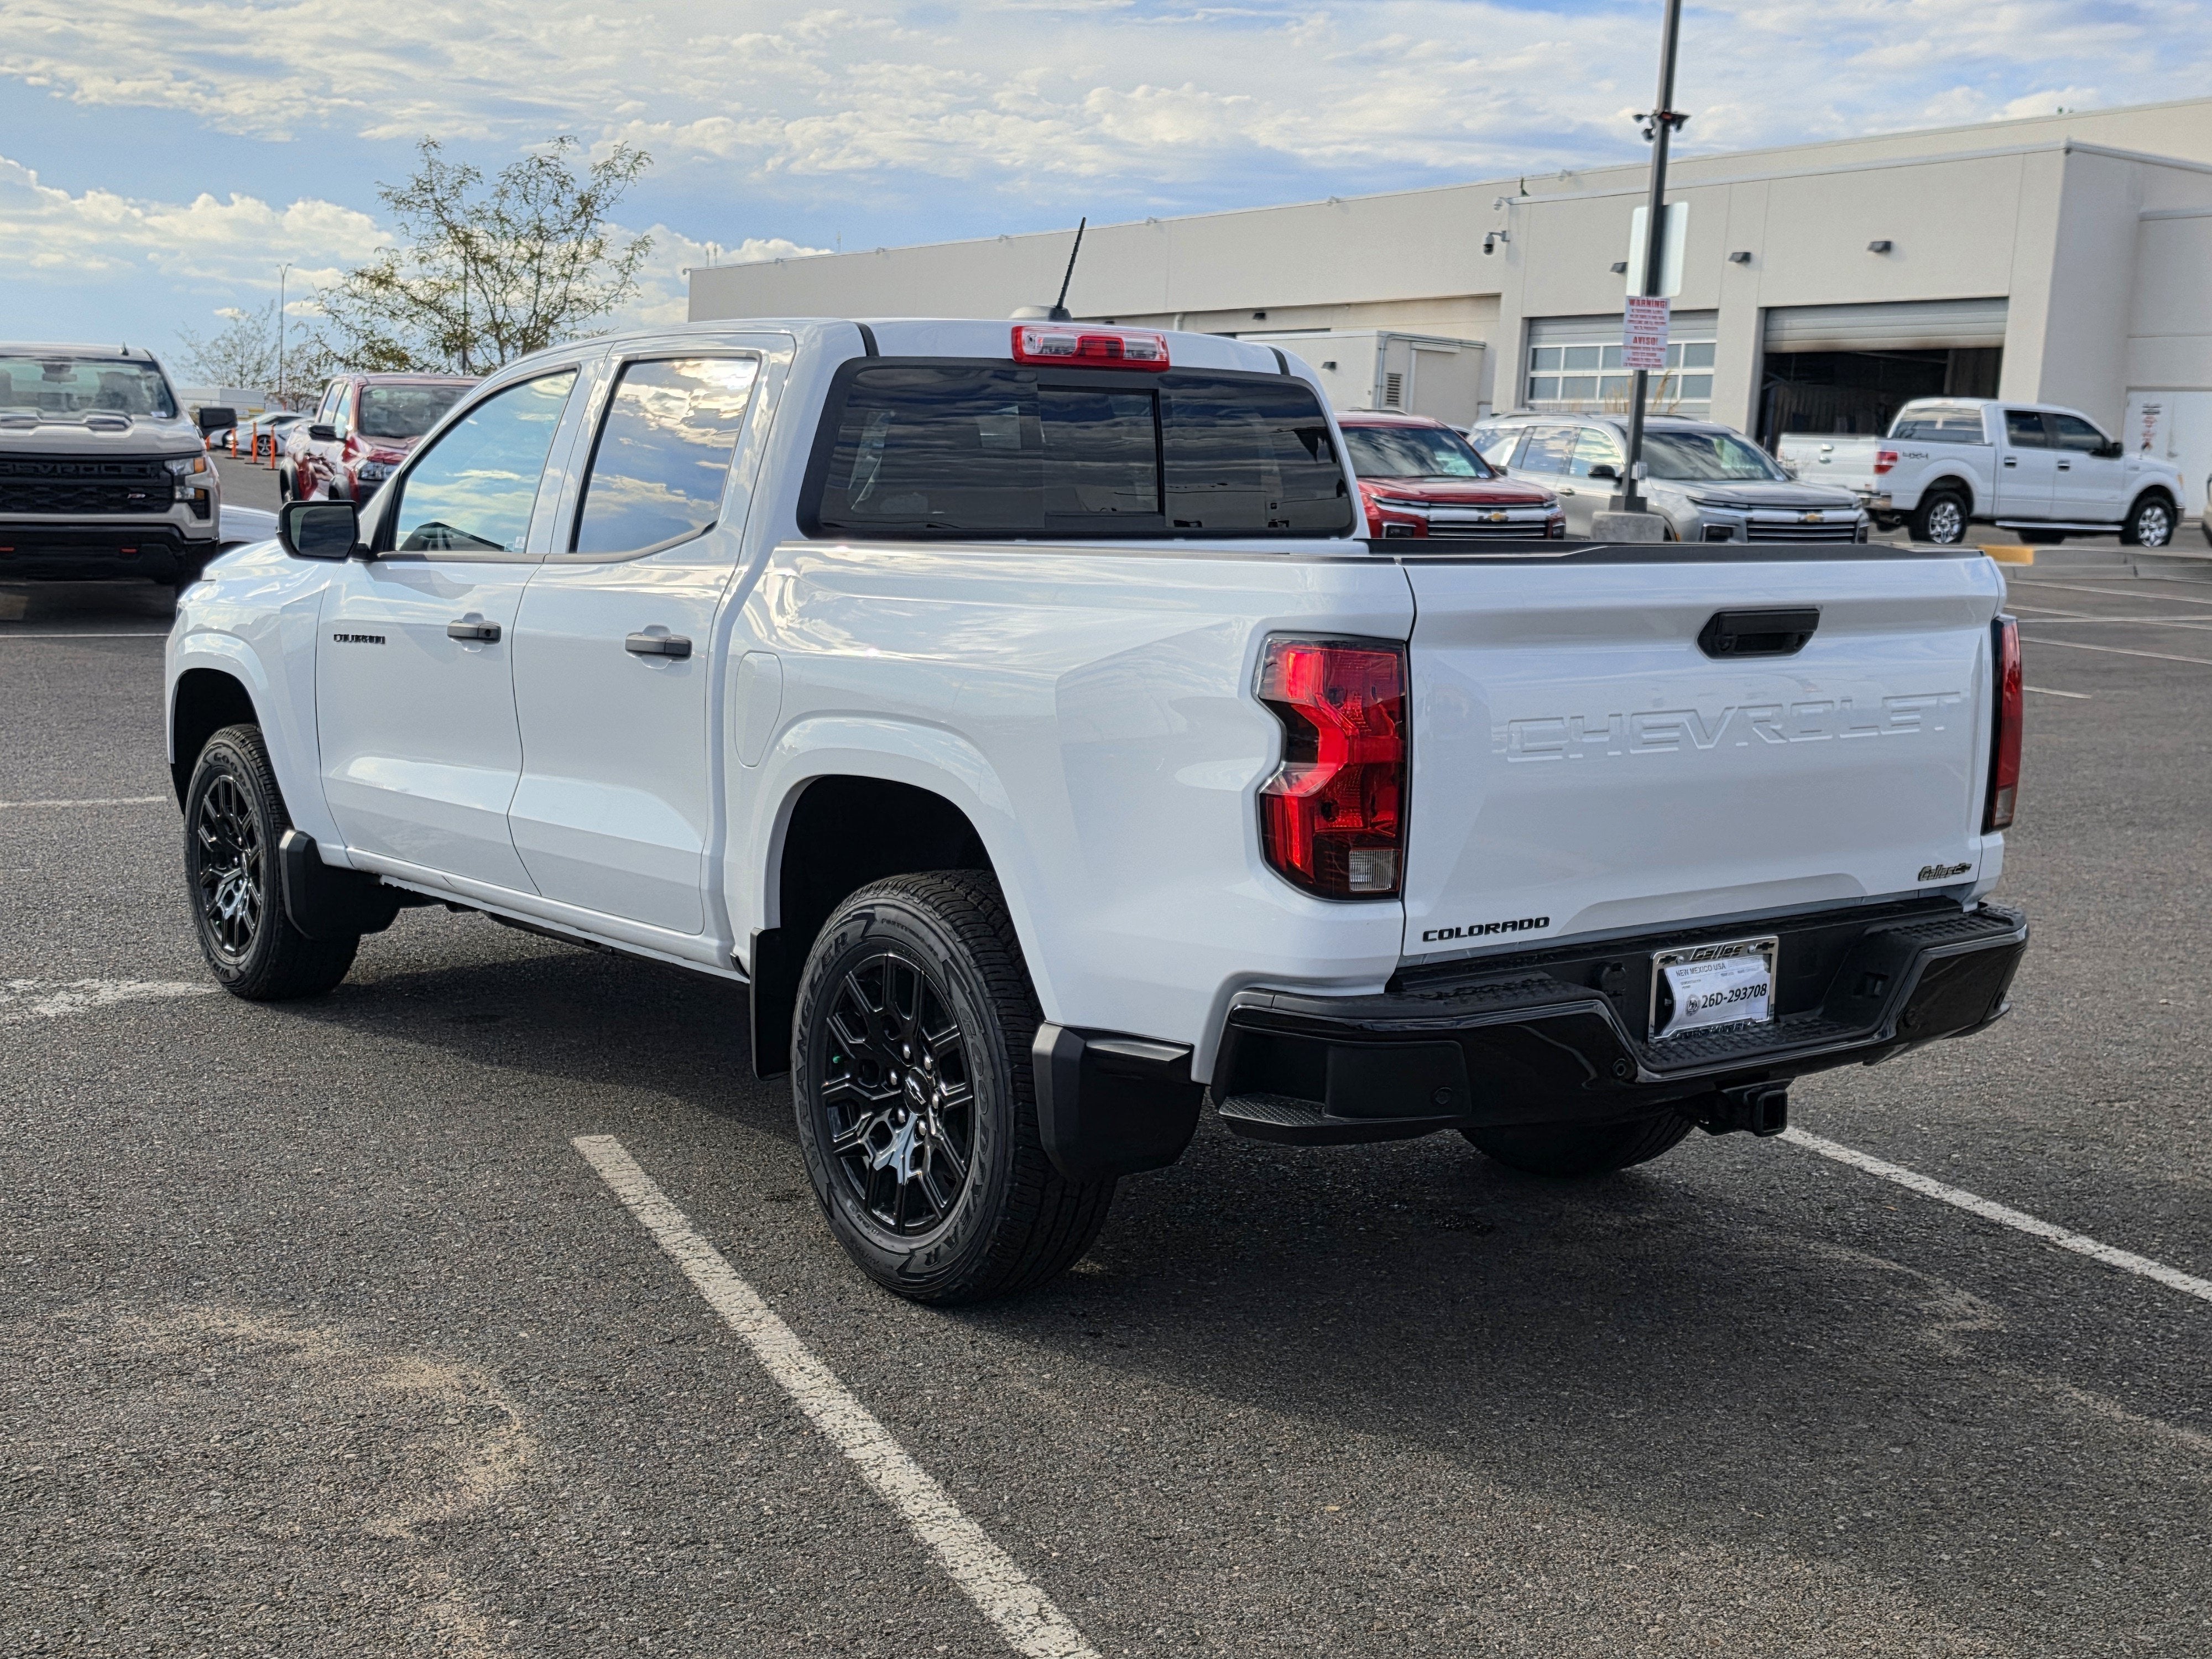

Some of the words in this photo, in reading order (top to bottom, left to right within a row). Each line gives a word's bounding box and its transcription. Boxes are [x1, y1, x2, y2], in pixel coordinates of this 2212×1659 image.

[1507, 691, 1960, 762] CHEVROLET
[1422, 916, 1550, 942] COLORADO
[1676, 969, 1689, 977] NEW
[1689, 965, 1713, 974] MEXICO
[1713, 962, 1726, 971] USA
[1701, 983, 1767, 1009] 26D-293708
